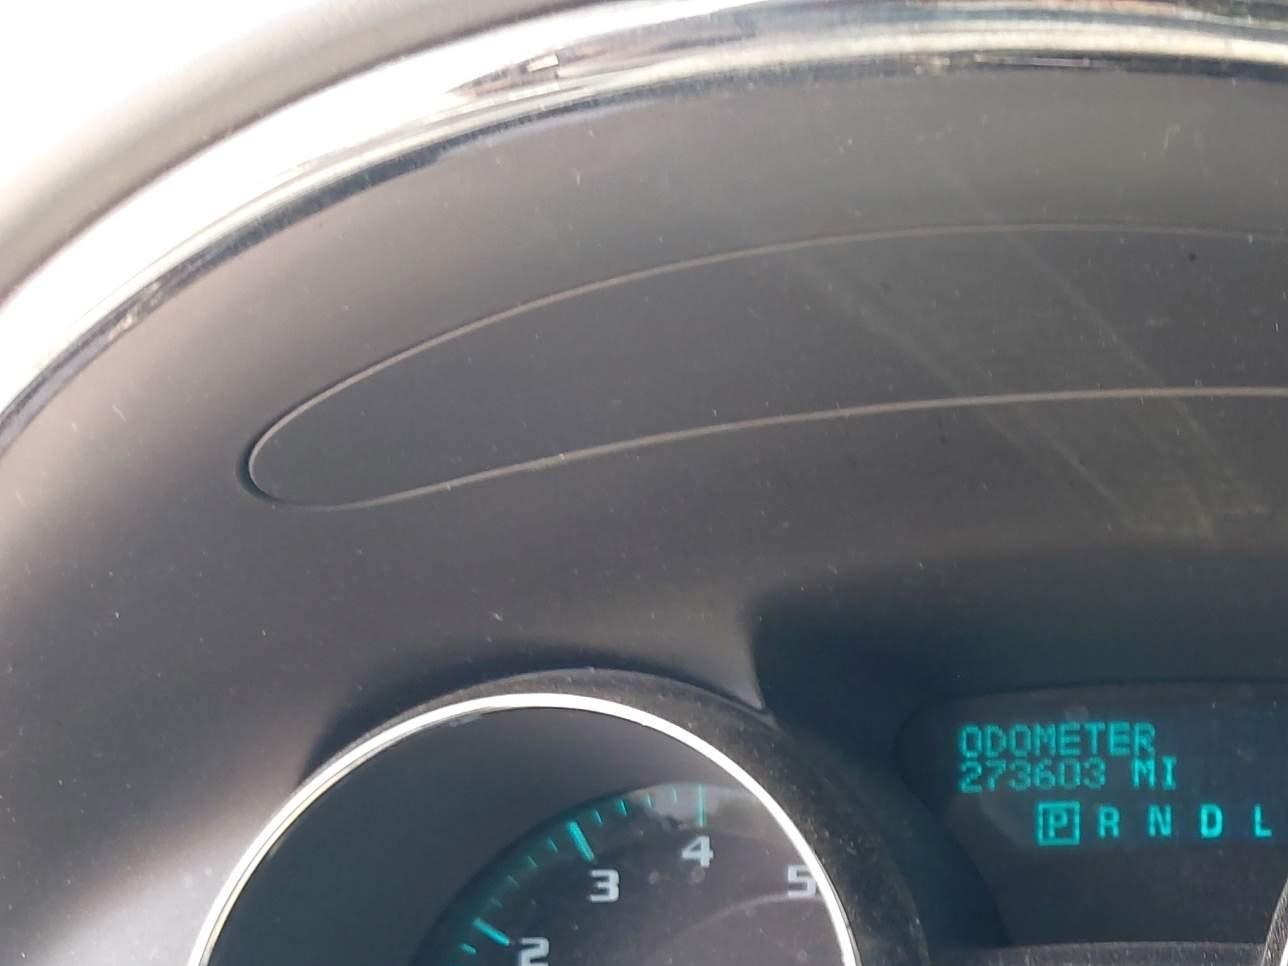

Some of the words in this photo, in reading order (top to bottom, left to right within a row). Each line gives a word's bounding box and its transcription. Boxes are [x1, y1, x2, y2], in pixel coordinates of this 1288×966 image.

[959, 722, 1156, 758] ODOMETER
[959, 756, 1106, 793] 273603
[1131, 757, 1178, 790] MI
[1047, 812, 1068, 838] P
[1098, 806, 1120, 838] R
[1148, 805, 1172, 837] N
[1200, 803, 1223, 838] D
[1254, 805, 1273, 837] L
[681, 836, 713, 867] 4
[590, 869, 619, 902] 3
[787, 865, 817, 898] 5
